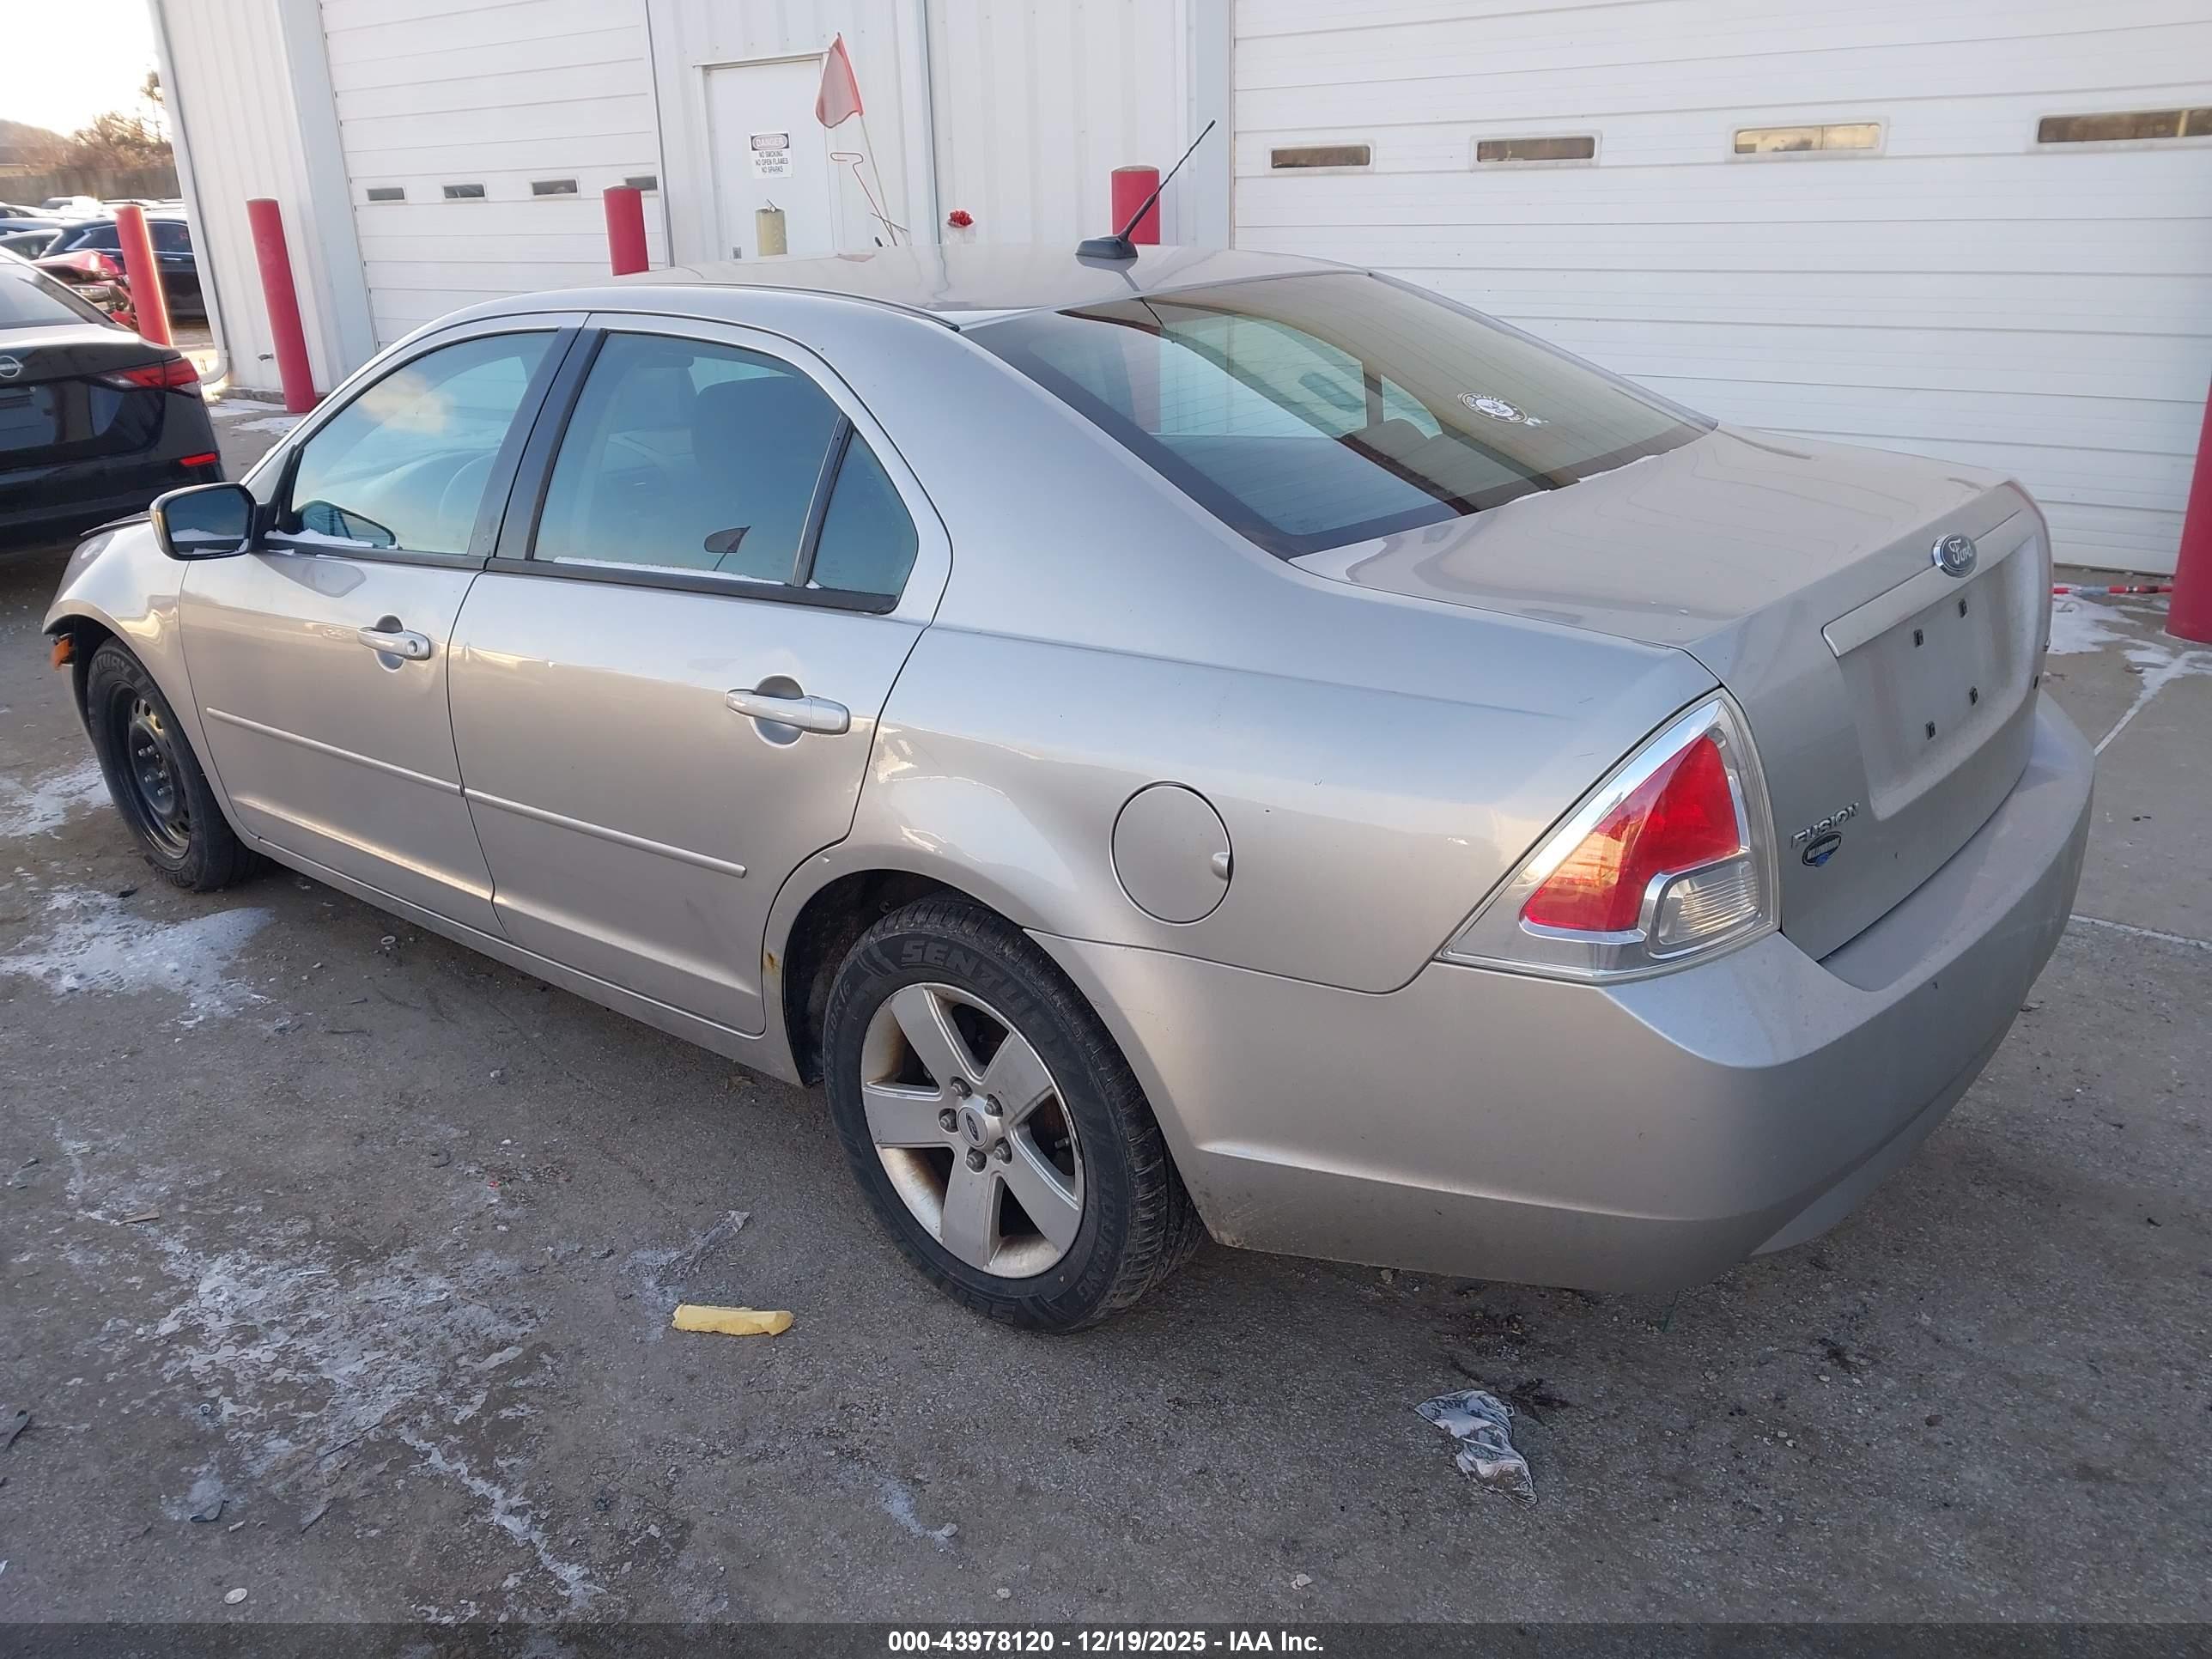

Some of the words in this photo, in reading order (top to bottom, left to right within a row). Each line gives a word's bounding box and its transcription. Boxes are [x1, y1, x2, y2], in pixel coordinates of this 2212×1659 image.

[755, 137, 783, 146] DANGER
[765, 149, 783, 158] SMOKING
[1948, 538, 1972, 565] Ford
[1790, 802, 1859, 848] FUSION
